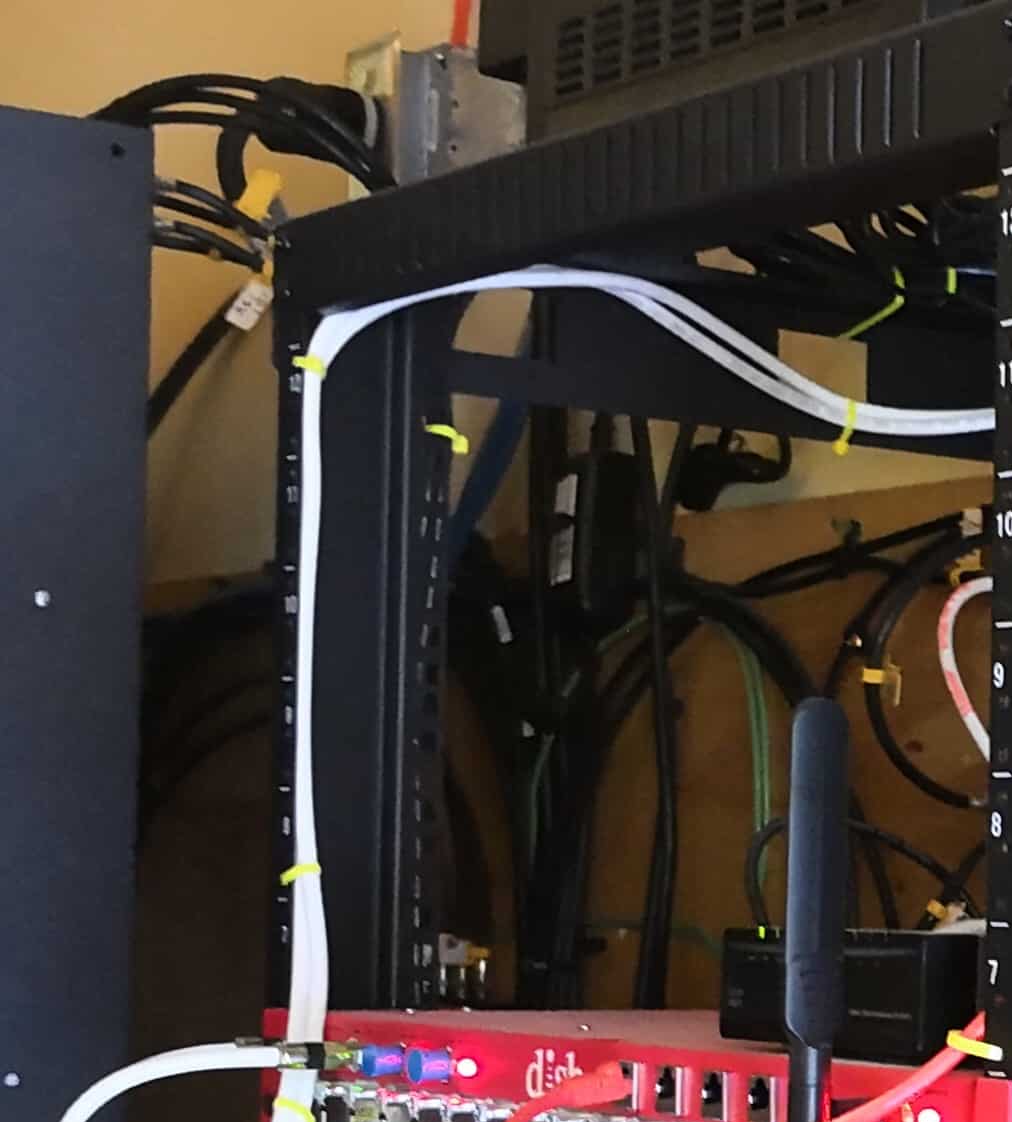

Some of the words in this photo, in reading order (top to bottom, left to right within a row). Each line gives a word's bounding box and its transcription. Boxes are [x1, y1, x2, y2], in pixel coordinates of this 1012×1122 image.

[993, 662, 1005, 688] 9
[991, 811, 1002, 837] 8
[987, 959, 999, 985] 7
